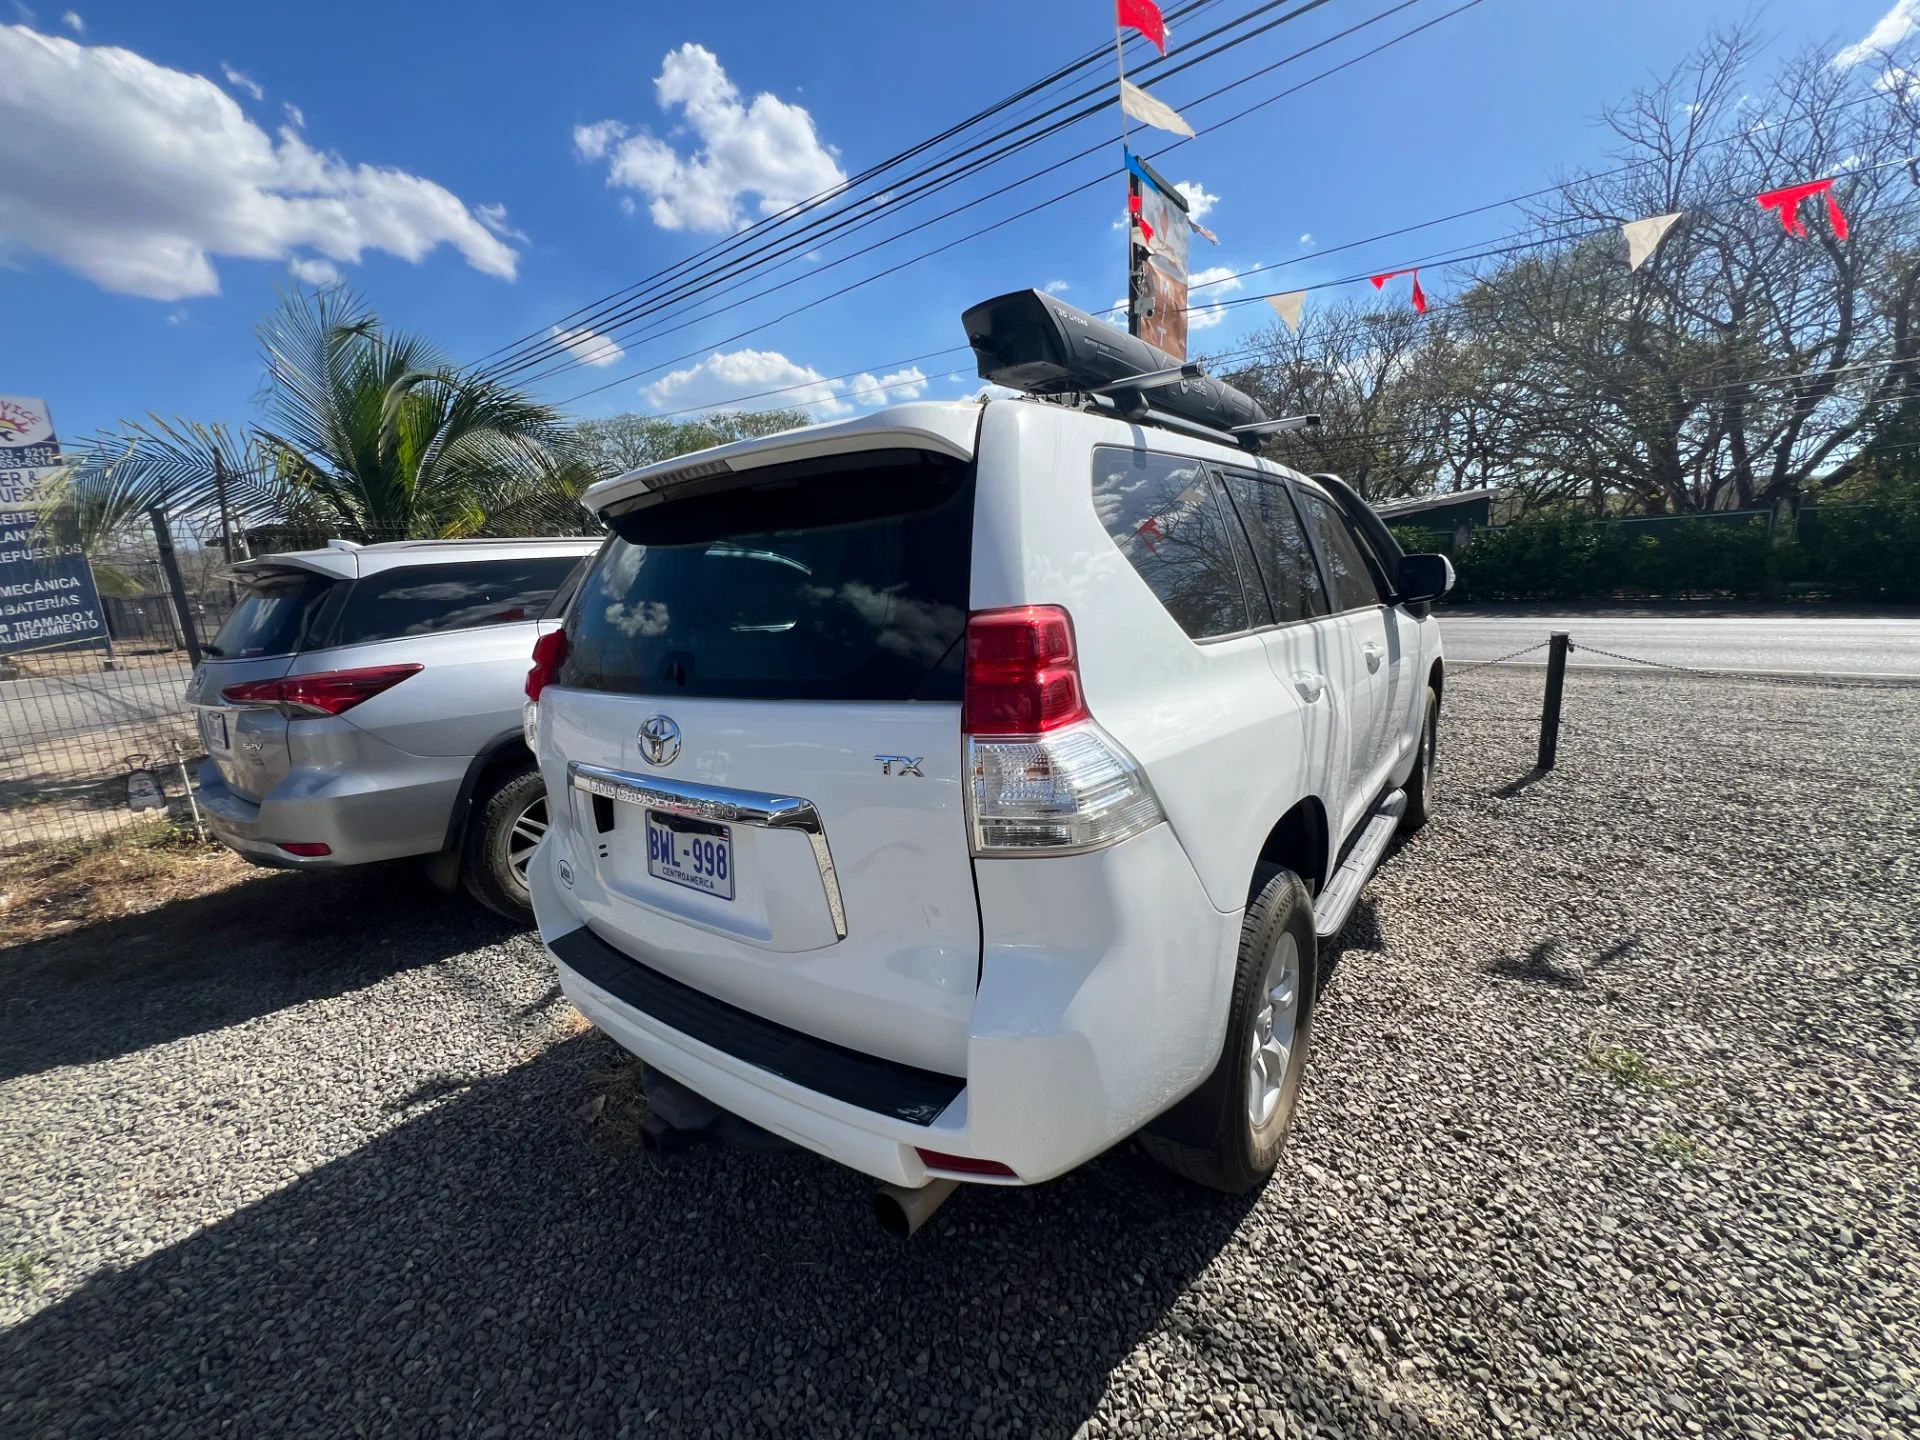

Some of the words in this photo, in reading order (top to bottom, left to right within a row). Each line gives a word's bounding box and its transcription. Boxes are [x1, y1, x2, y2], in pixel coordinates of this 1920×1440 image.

[0, 576, 81, 597] MECÁNICA
[4, 594, 80, 616] BATERÍAS
[0, 619, 99, 644] ALINEAMIENTO
[12, 612, 82, 632] TRAMADO
[84, 609, 94, 620] Y
[874, 755, 925, 778] TX
[650, 827, 728, 881] BWL-998
[662, 866, 715, 889] CENTROAMERICA
